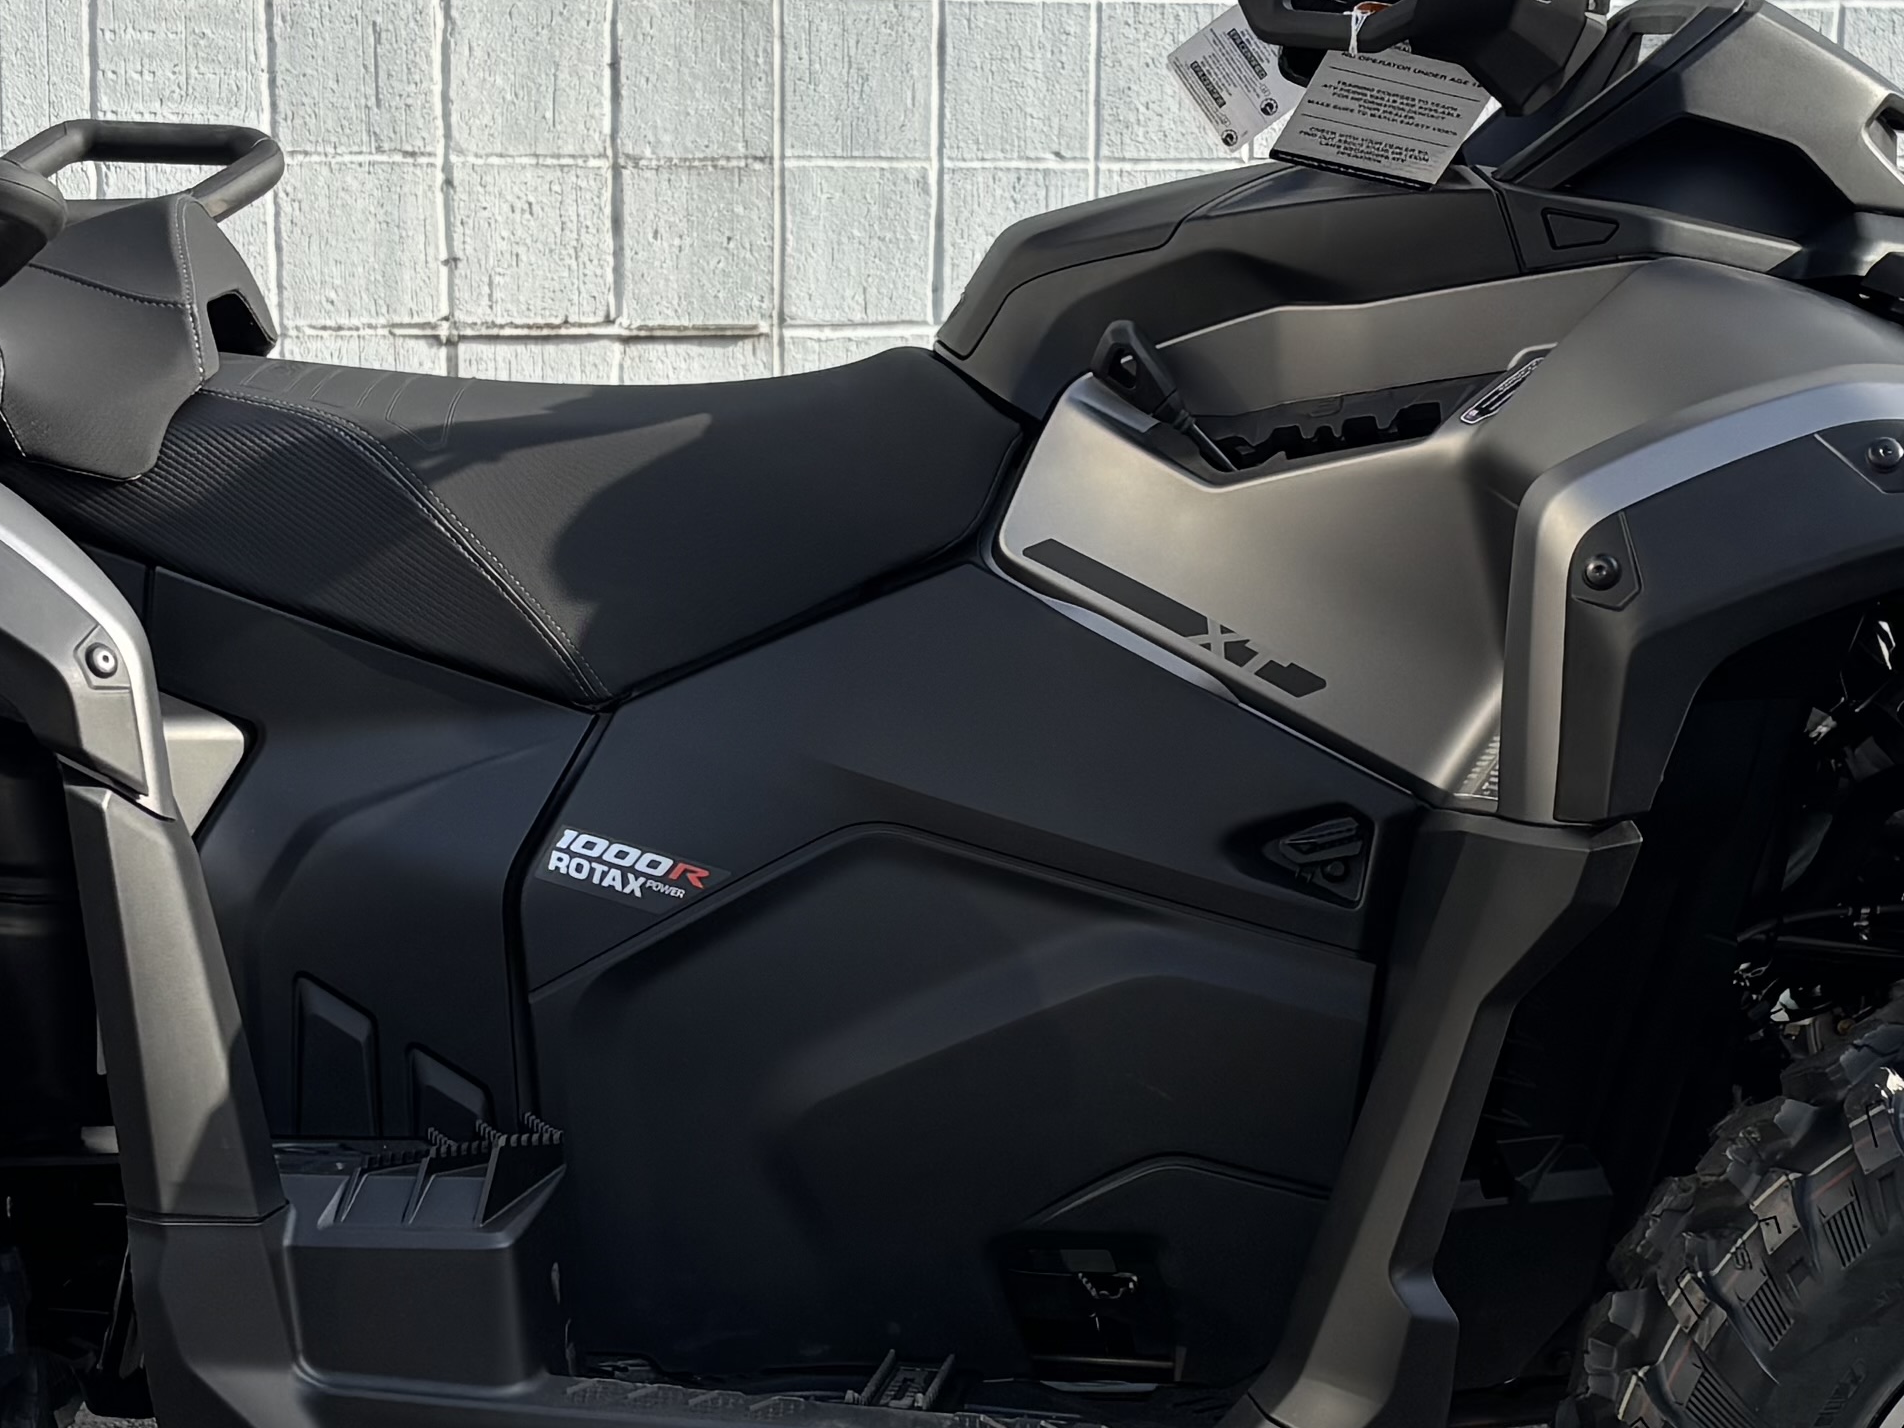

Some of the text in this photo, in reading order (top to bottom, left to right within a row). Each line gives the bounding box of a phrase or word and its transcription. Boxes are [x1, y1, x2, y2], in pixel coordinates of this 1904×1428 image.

[1358, 54, 1412, 73] OPERATOR
[1413, 67, 1447, 81] UNDER
[547, 850, 686, 899] ROTAX POWER
[556, 828, 710, 890] 1000R
